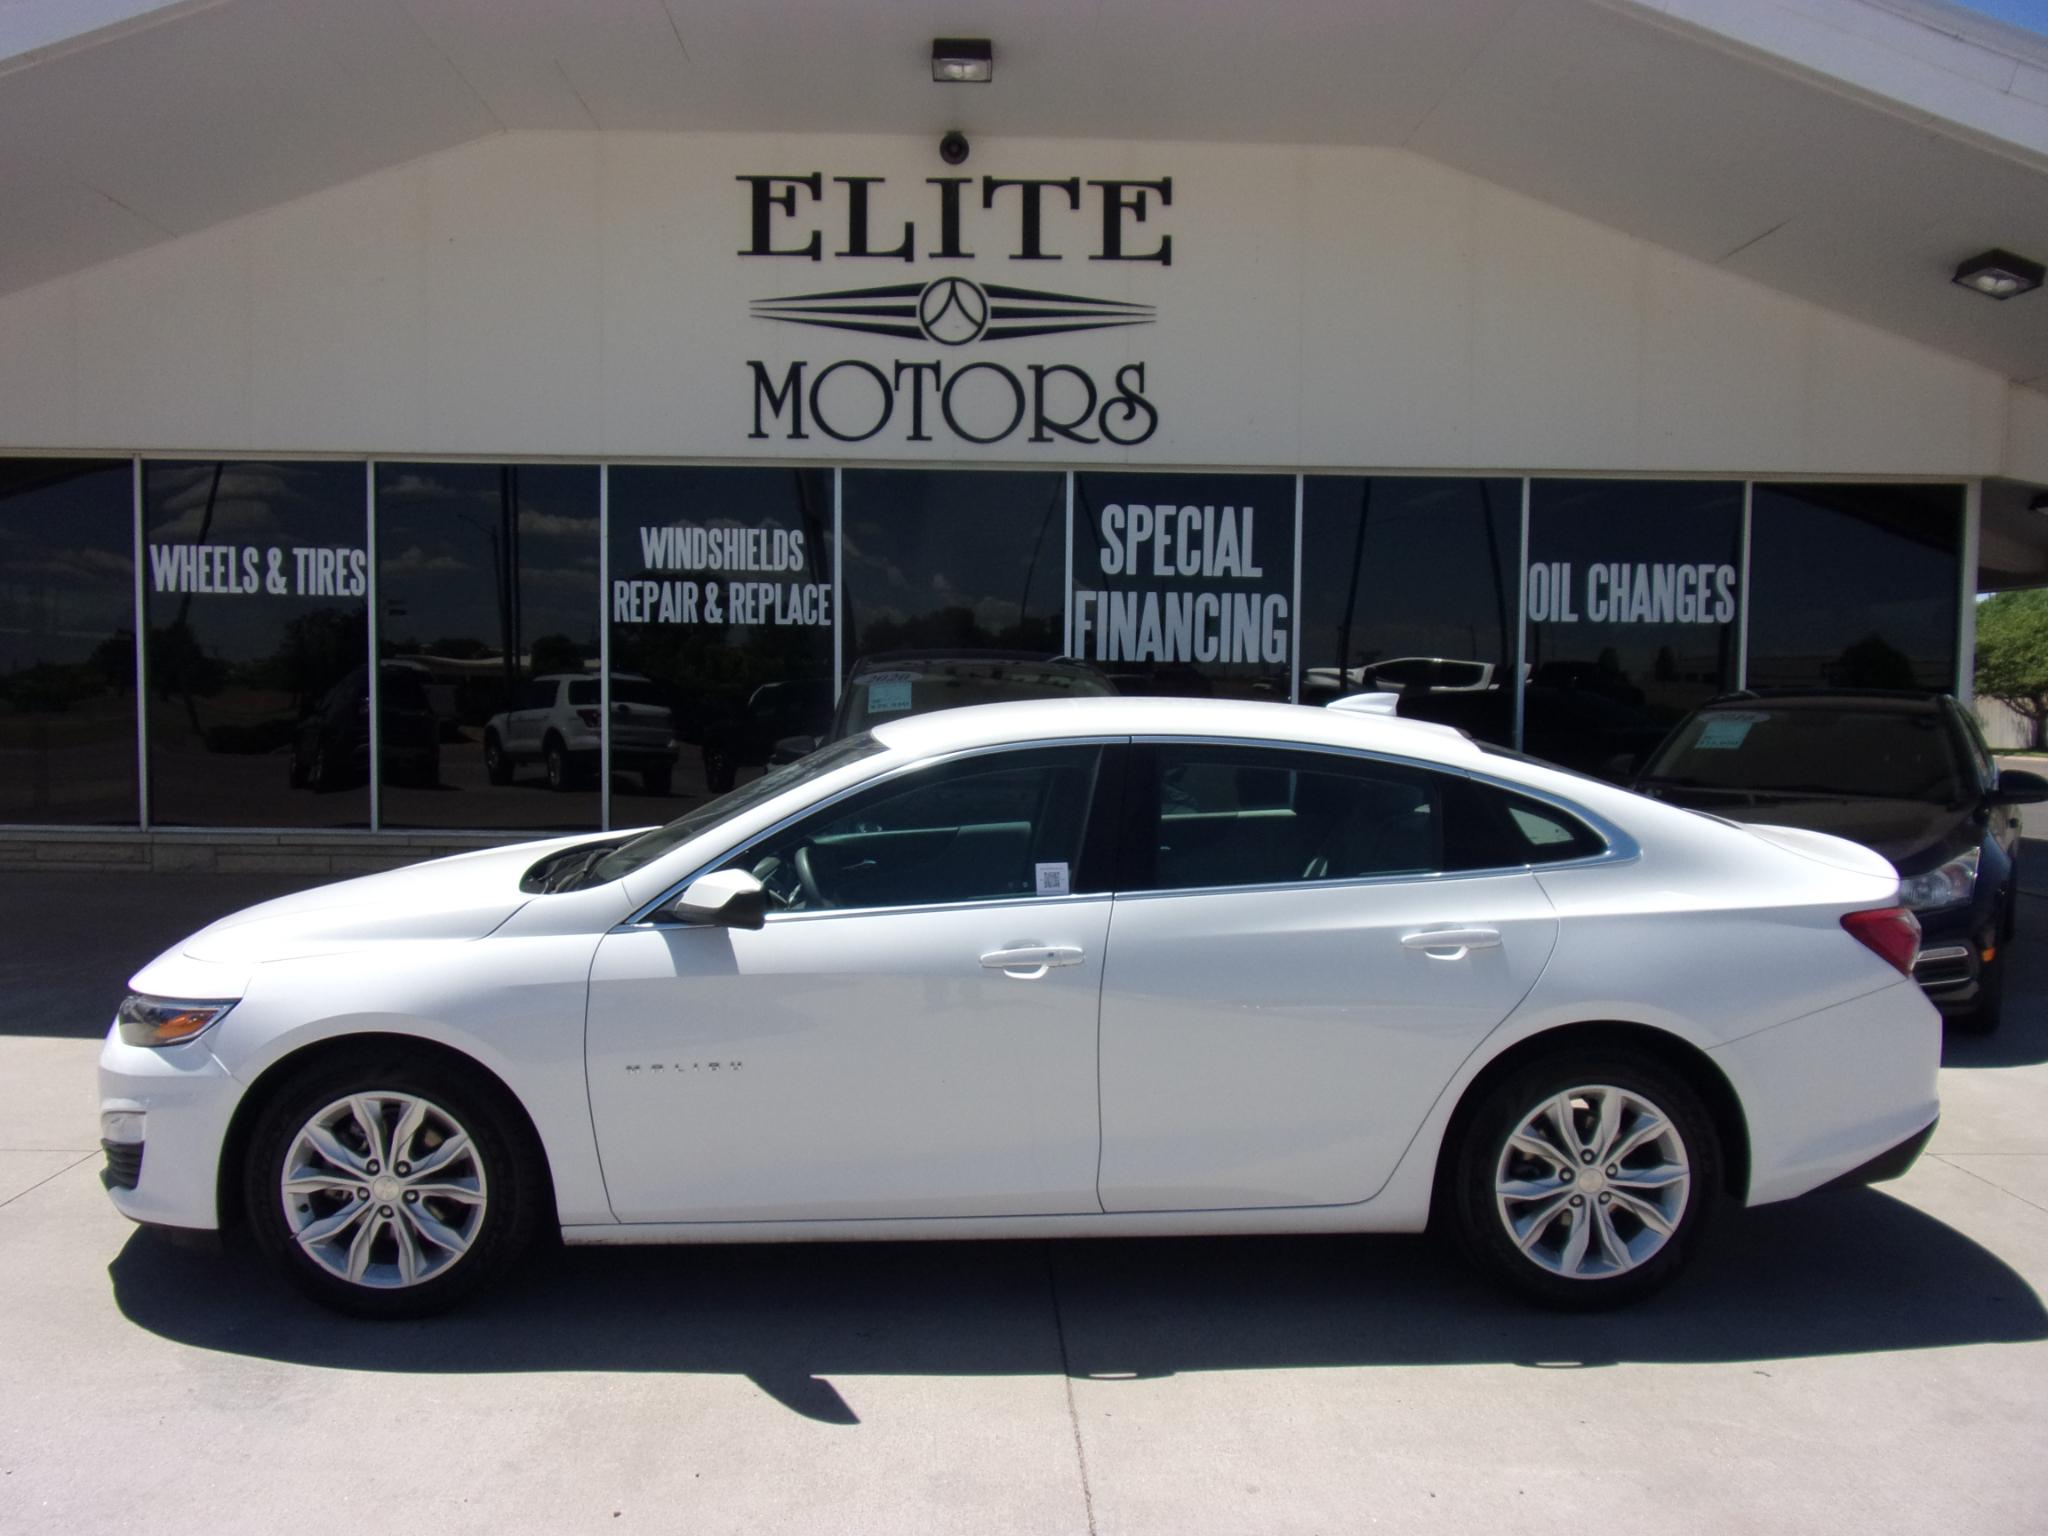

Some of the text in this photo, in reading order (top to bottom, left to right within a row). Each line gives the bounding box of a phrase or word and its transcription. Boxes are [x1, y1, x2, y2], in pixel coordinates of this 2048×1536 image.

[736, 171, 1172, 266] ELITE
[746, 359, 1158, 445] MOTORS
[149, 544, 366, 596] WHEELS & TIRES
[640, 526, 804, 571] WINDSHIELDS
[1100, 504, 1263, 577] SPECIAL
[613, 580, 832, 625] REPAIR & REPLACE
[1528, 562, 1736, 623] OIL CHANGES
[1074, 590, 1288, 664] FINANCING
